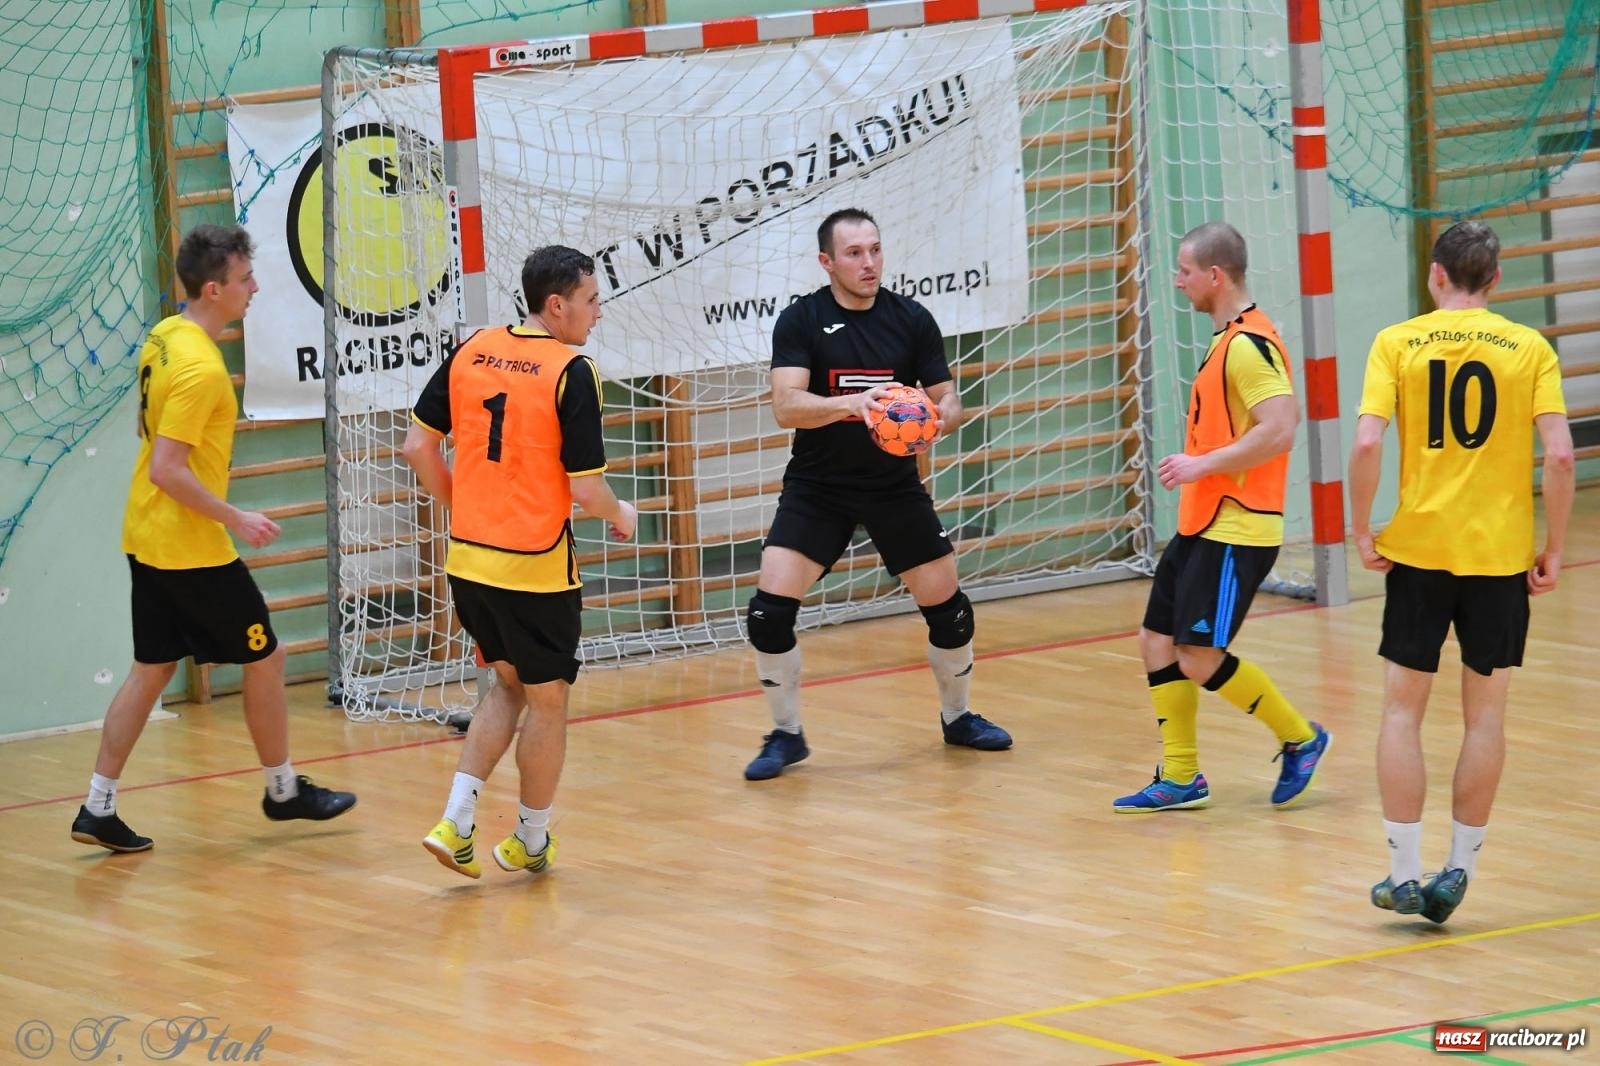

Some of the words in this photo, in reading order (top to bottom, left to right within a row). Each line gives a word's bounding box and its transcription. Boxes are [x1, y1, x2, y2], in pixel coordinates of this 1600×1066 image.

[536, 44, 571, 60] sport
[454, 257, 462, 320] sport
[1477, 332, 1519, 351] ROGÓW
[1428, 359, 1497, 449] 10
[483, 392, 507, 463] 1
[247, 623, 267, 650] 8
